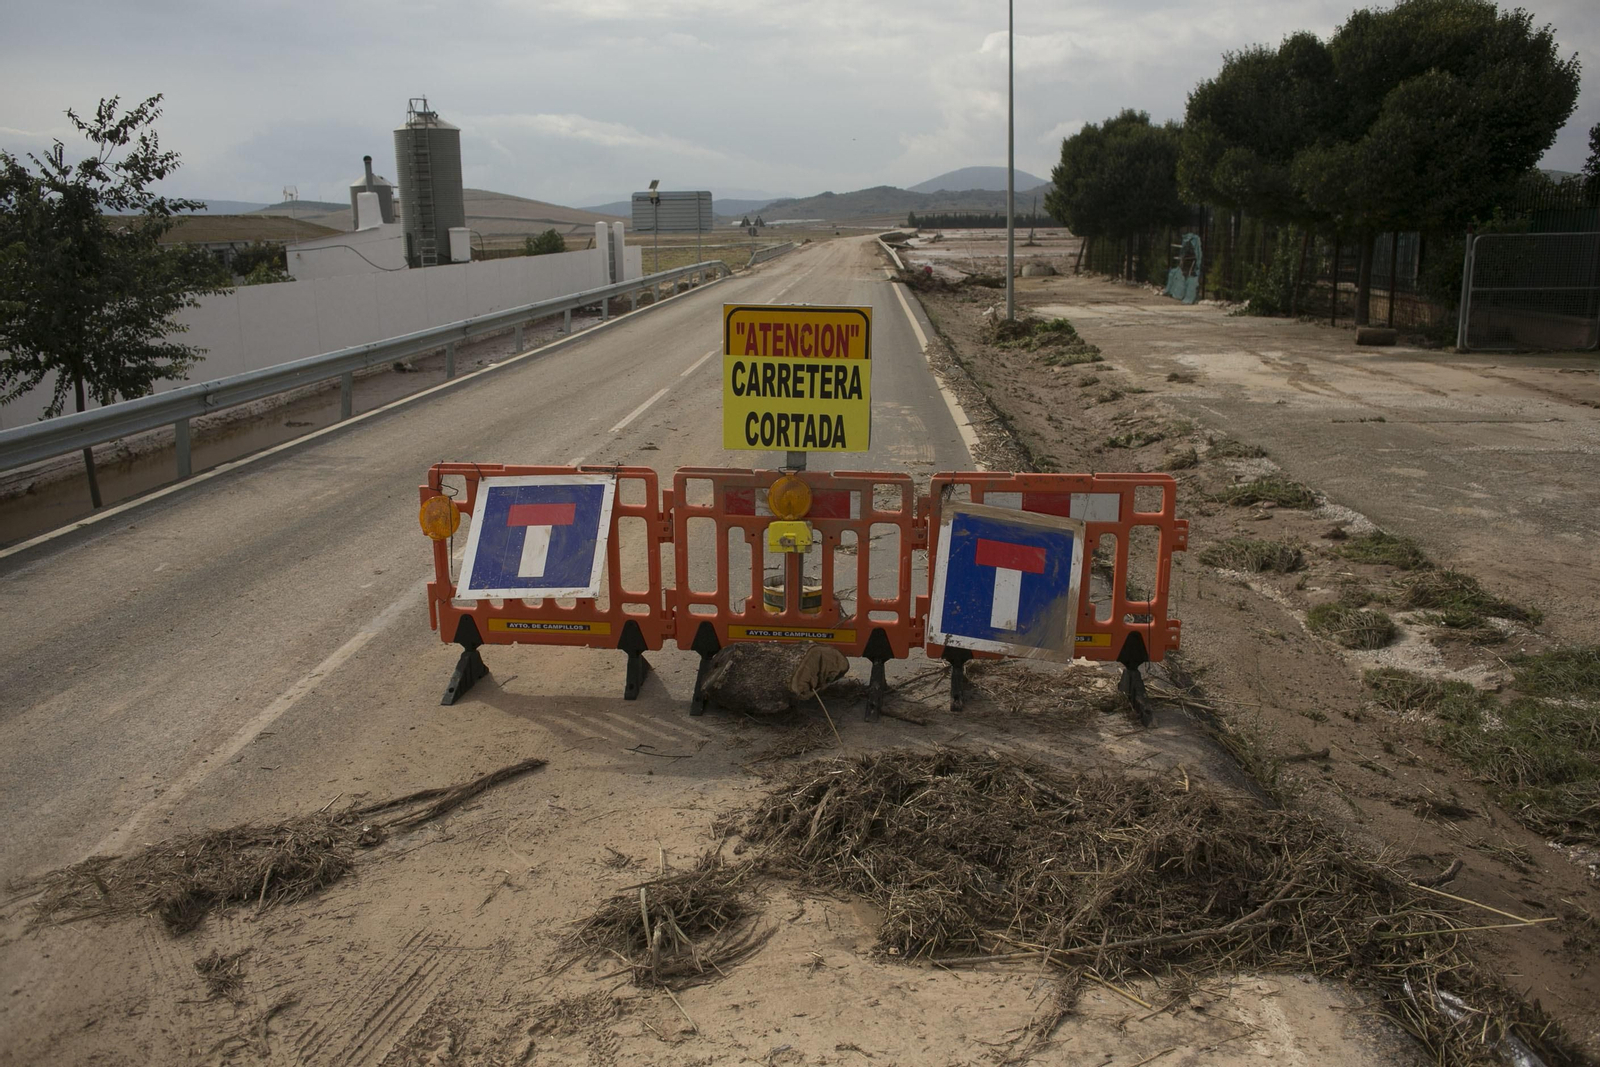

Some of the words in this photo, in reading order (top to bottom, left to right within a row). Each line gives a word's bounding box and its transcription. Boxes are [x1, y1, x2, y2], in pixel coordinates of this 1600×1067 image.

[736, 322, 860, 358] "ATENCION"
[731, 360, 863, 400] CARRETERA
[745, 411, 847, 449] CORTADA
